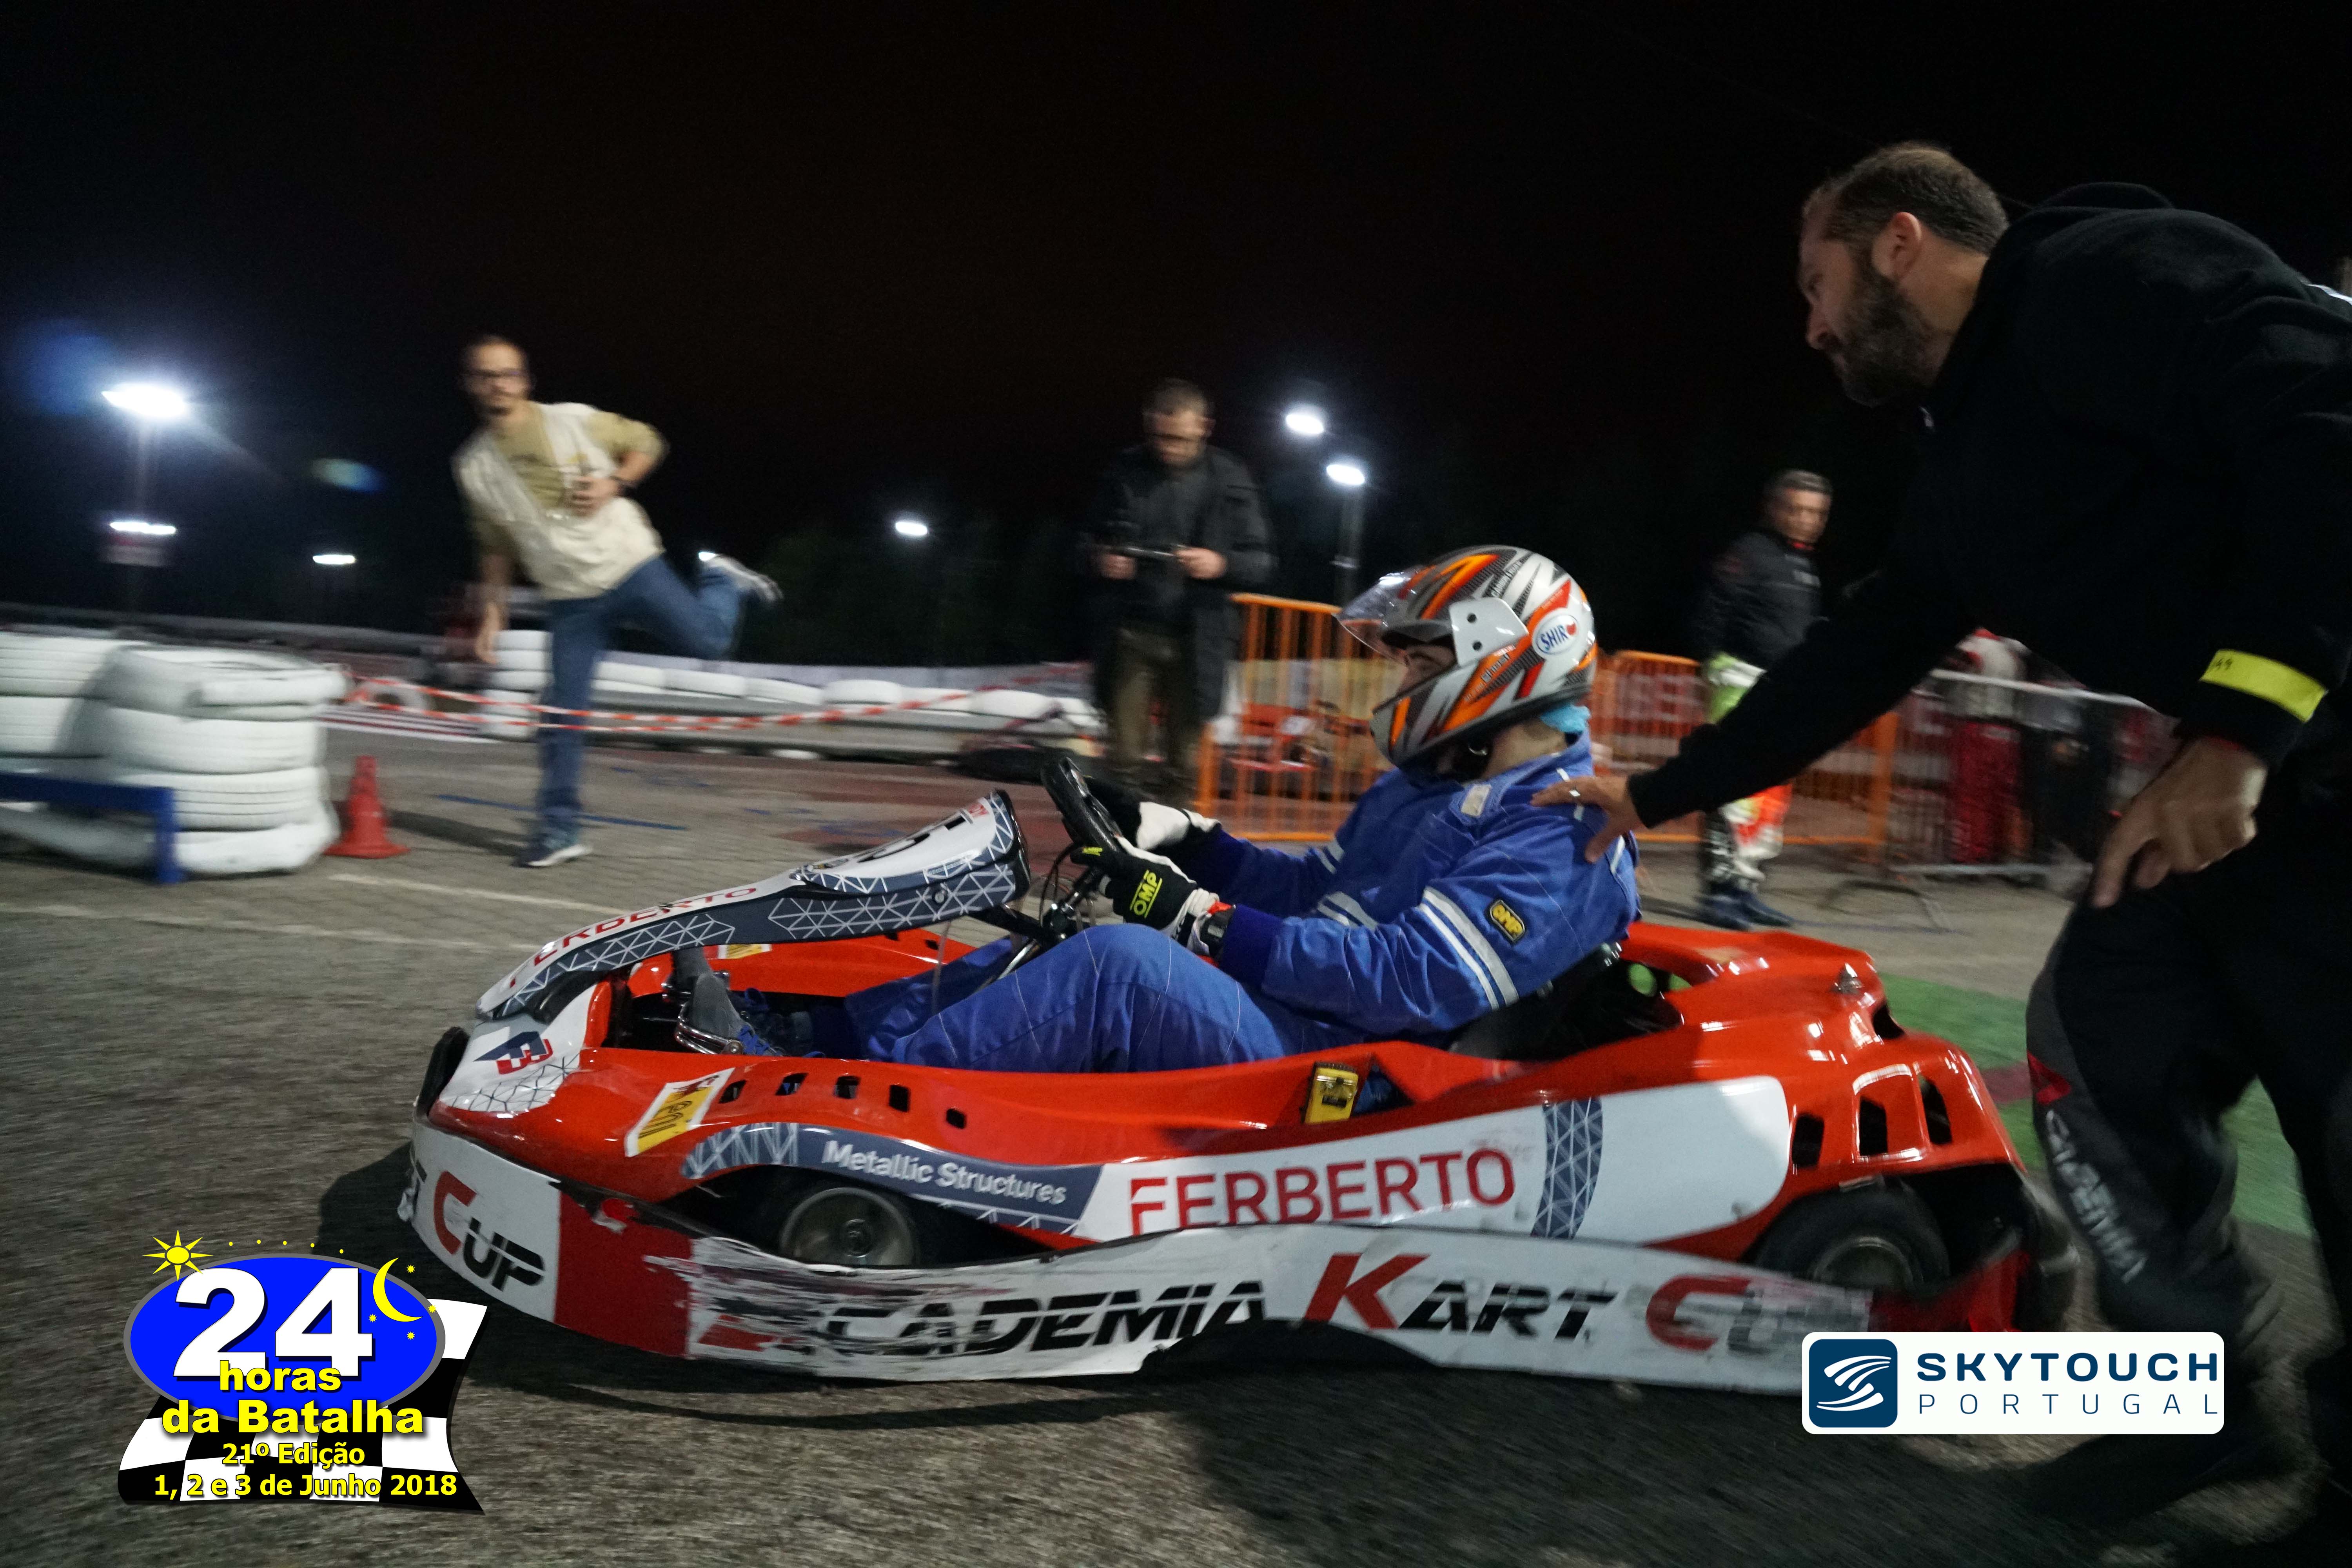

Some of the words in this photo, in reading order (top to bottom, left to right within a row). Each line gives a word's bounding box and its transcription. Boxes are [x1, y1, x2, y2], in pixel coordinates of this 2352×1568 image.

[1132, 871, 1157, 916] OMP
[822, 1140, 934, 1183] Metallic
[936, 1162, 1067, 1205] Structures
[1130, 1148, 1516, 1236] FERBERTO
[433, 1170, 546, 1291] CUP
[1304, 1253, 1618, 1341] KART
